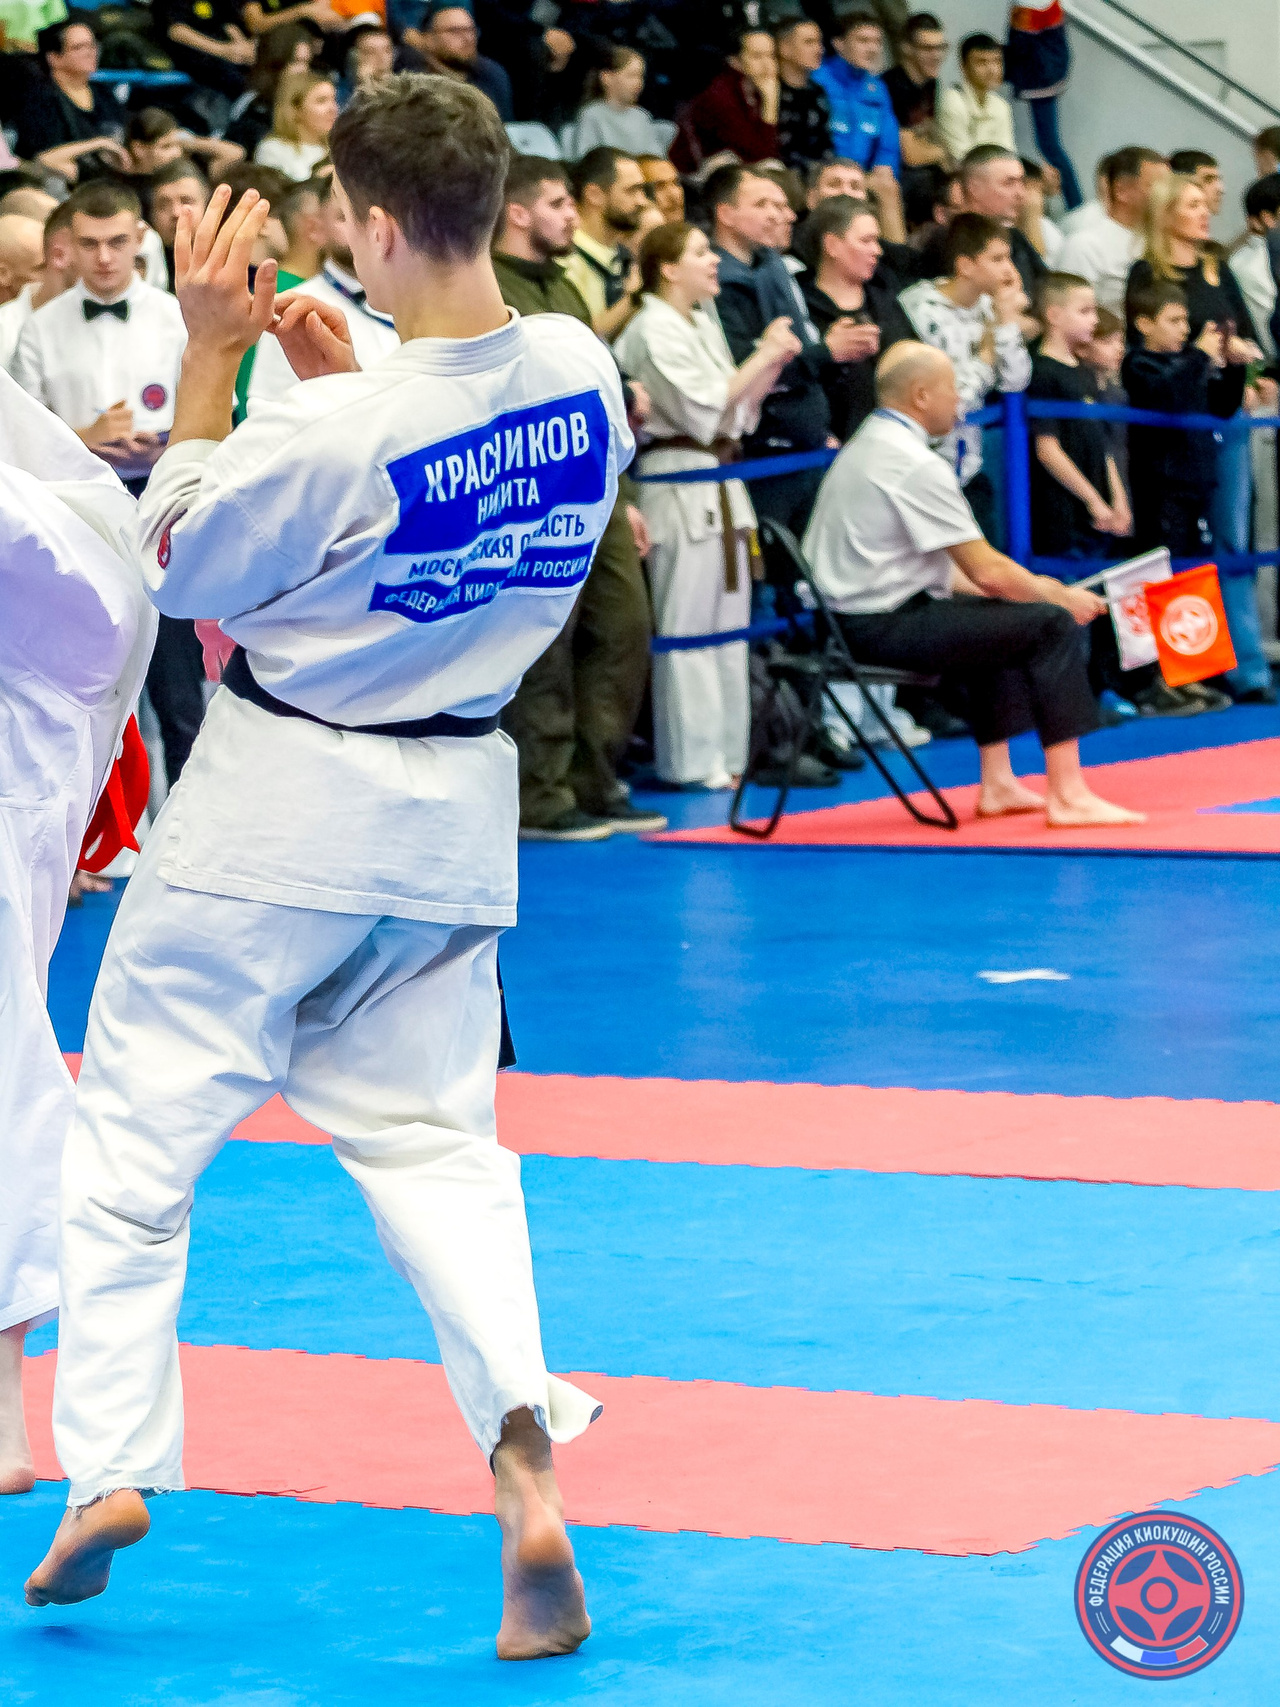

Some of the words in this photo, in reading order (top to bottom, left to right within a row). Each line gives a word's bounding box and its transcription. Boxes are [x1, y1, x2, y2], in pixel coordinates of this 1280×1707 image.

[477, 478, 540, 525] НИИТА
[408, 534, 514, 578] МОСКСКАЯ
[521, 514, 585, 552] ОАСТЬ
[532, 555, 588, 578] РОССИИ
